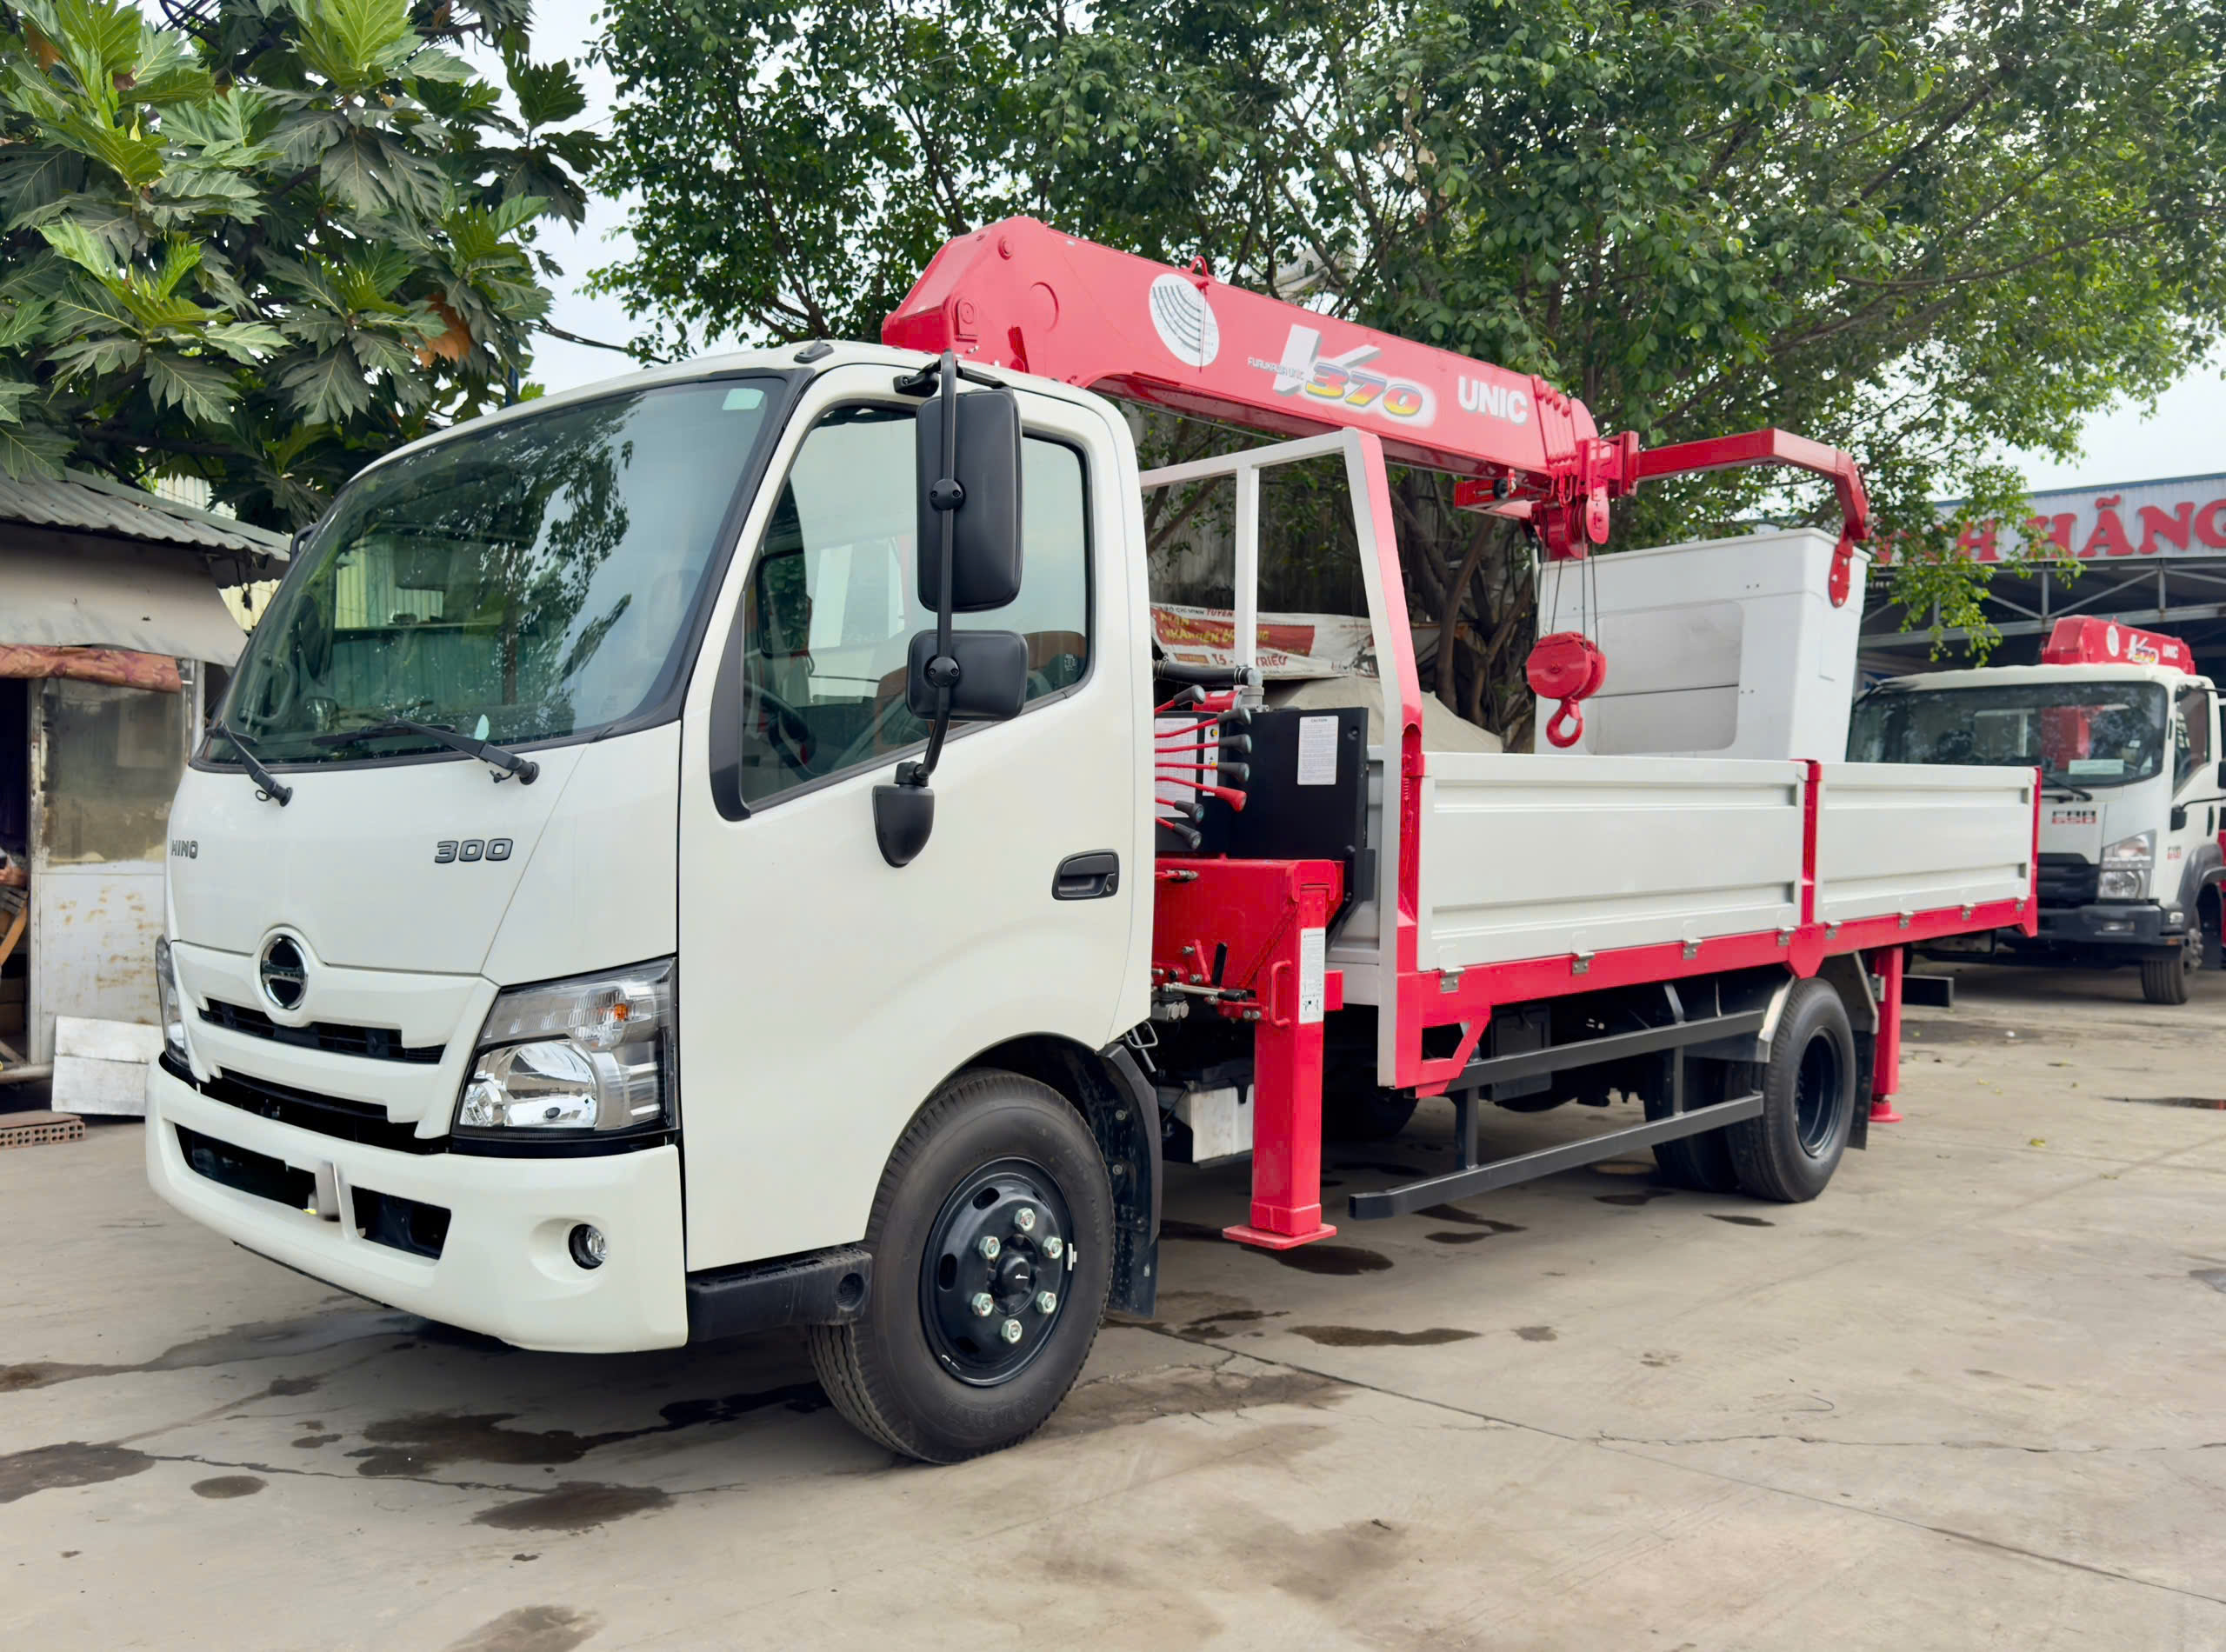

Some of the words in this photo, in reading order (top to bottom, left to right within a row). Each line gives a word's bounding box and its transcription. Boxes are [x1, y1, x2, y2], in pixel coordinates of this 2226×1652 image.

[1458, 375, 1529, 425] UNIC
[170, 839, 199, 860] HINO
[434, 837, 514, 864] 300
